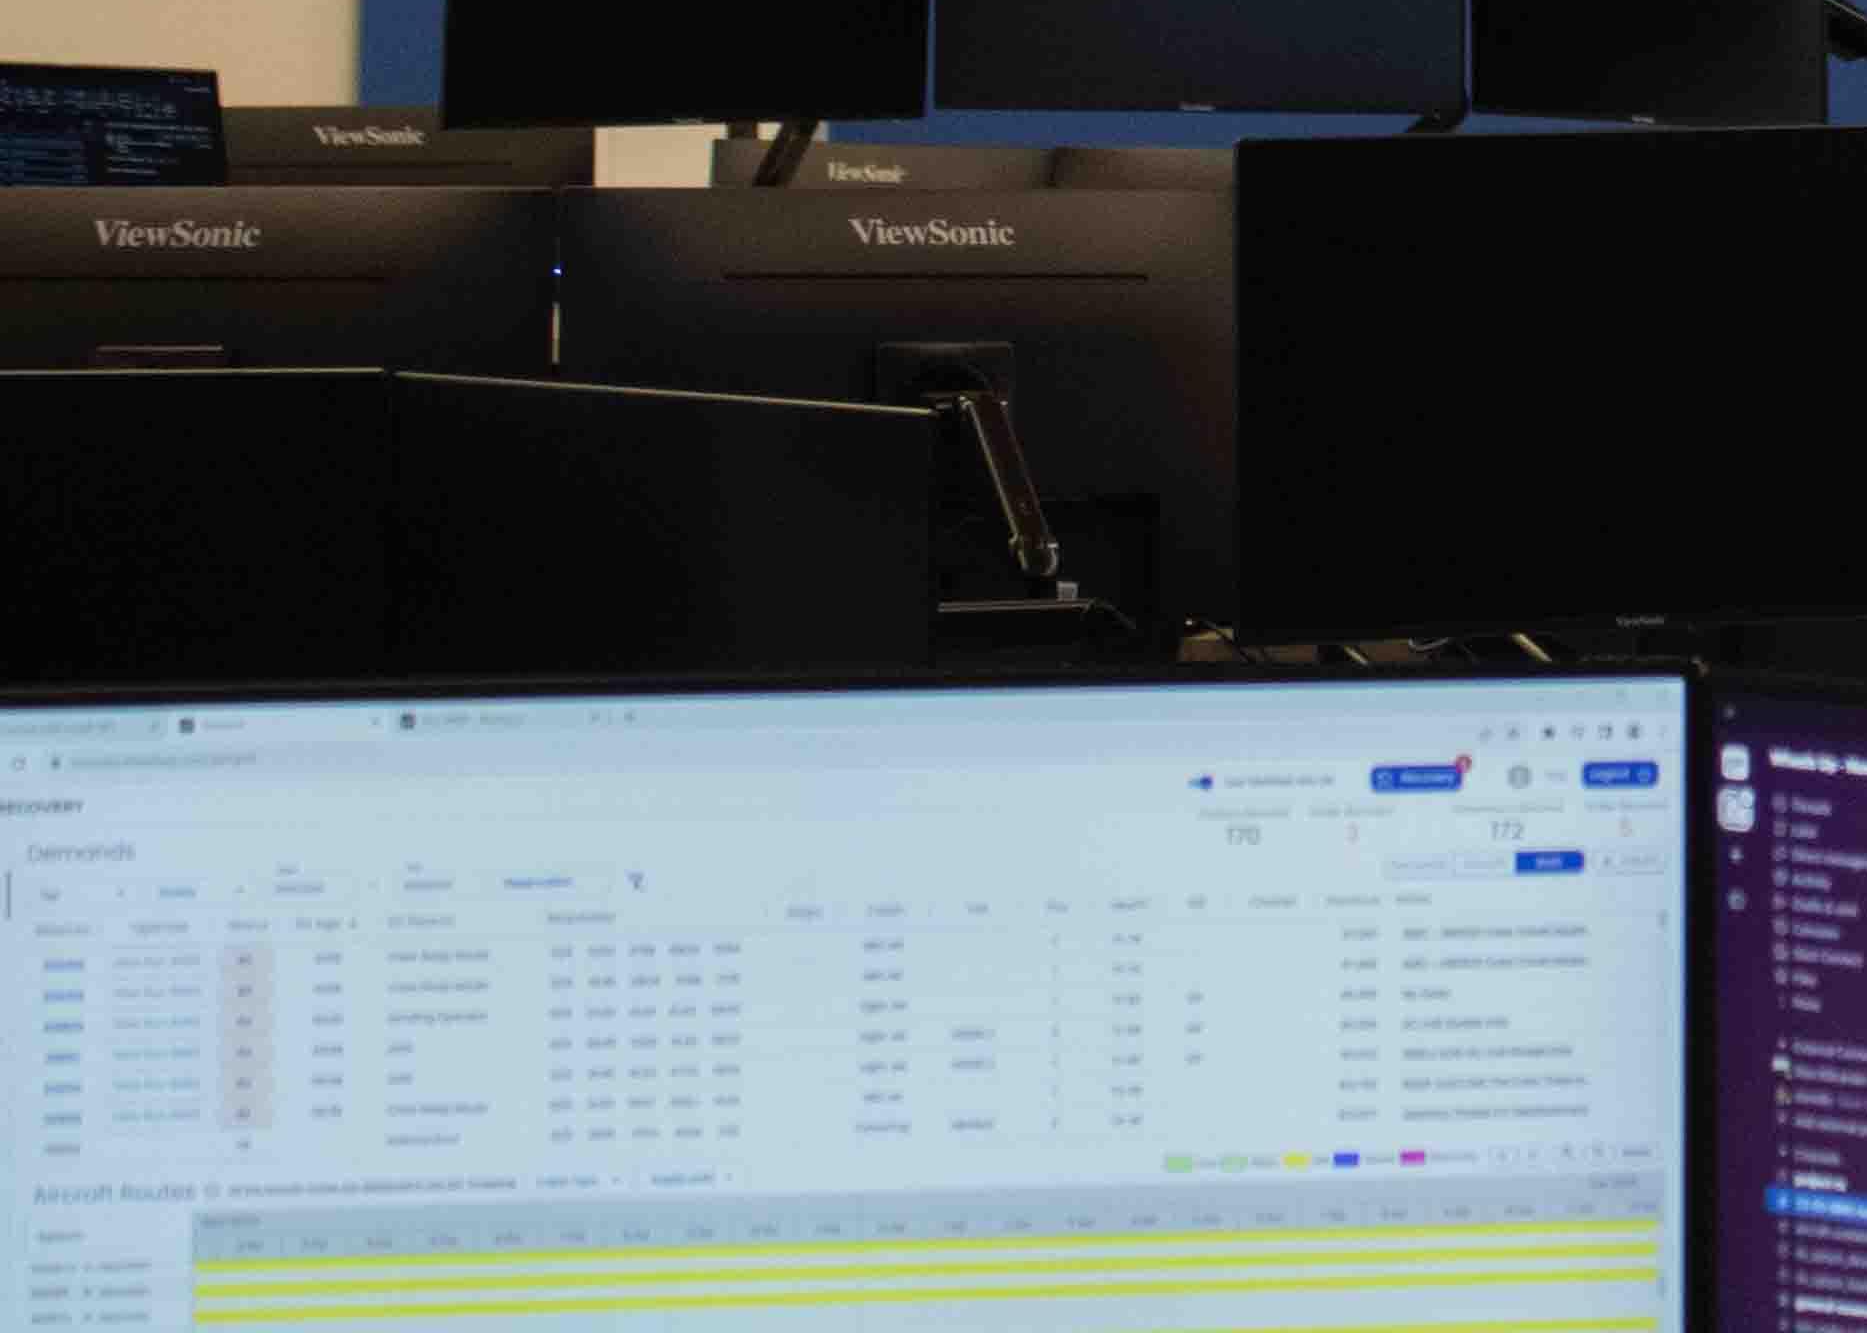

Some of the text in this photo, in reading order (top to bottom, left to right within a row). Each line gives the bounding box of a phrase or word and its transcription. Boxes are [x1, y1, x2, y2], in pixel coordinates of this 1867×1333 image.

[312, 125, 429, 147] ViewSonic
[94, 219, 261, 250] ViewSonic
[849, 216, 1016, 248] ViewSonic
